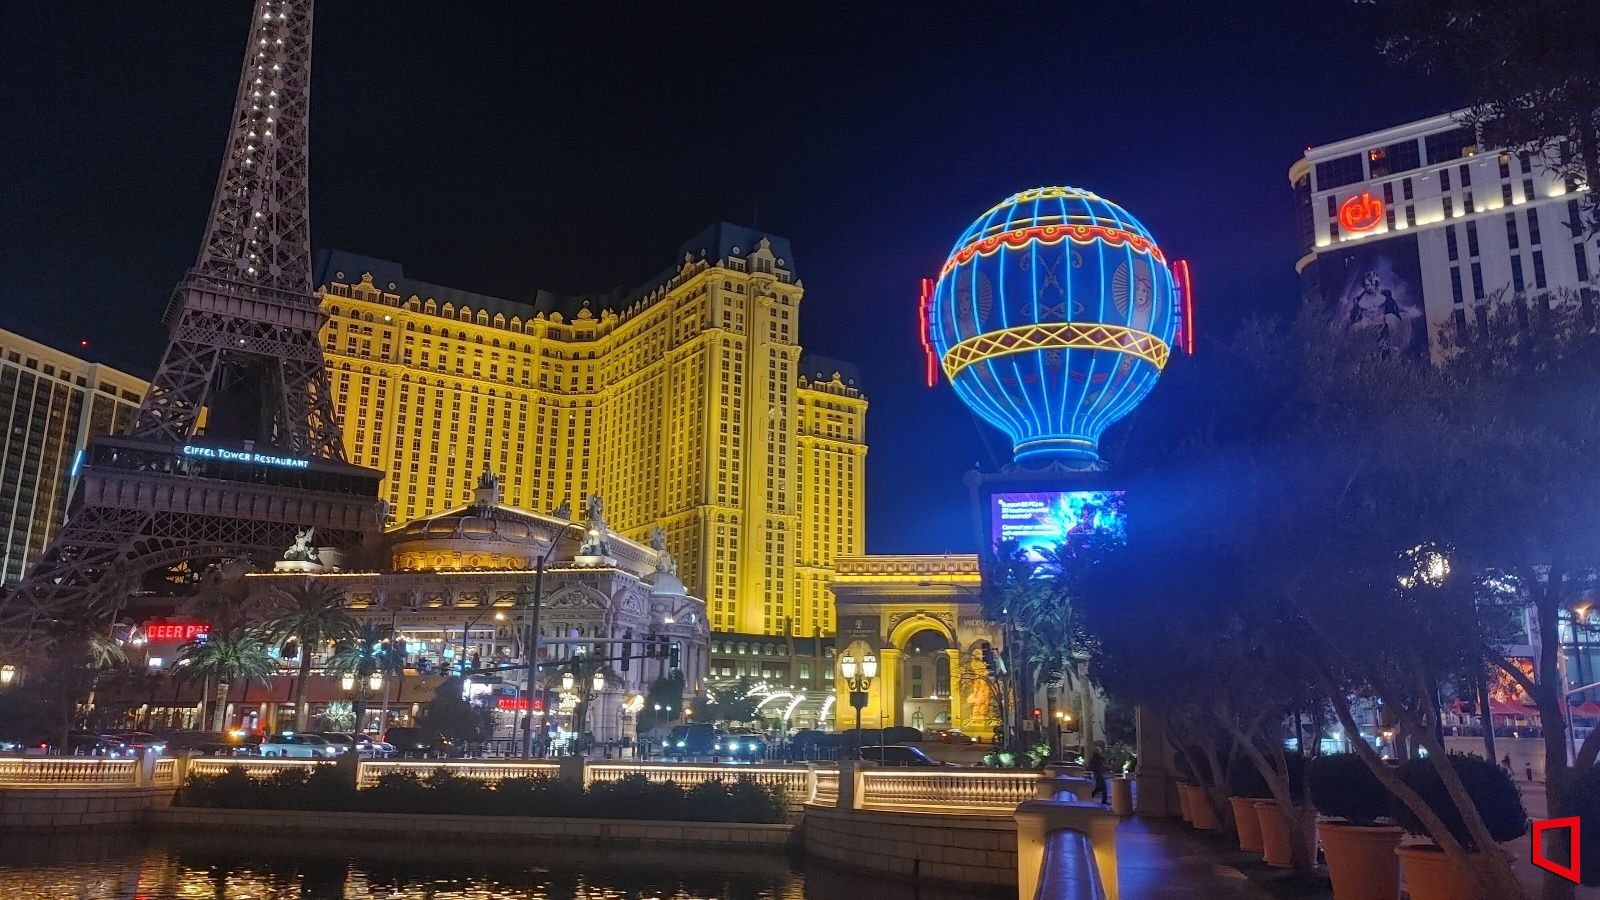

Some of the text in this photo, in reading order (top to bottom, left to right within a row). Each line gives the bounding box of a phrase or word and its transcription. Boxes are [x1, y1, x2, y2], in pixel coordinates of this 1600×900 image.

[183, 445, 309, 469] EIFFEL TOWER RESTAURANT
[147, 625, 183, 638] BEER
